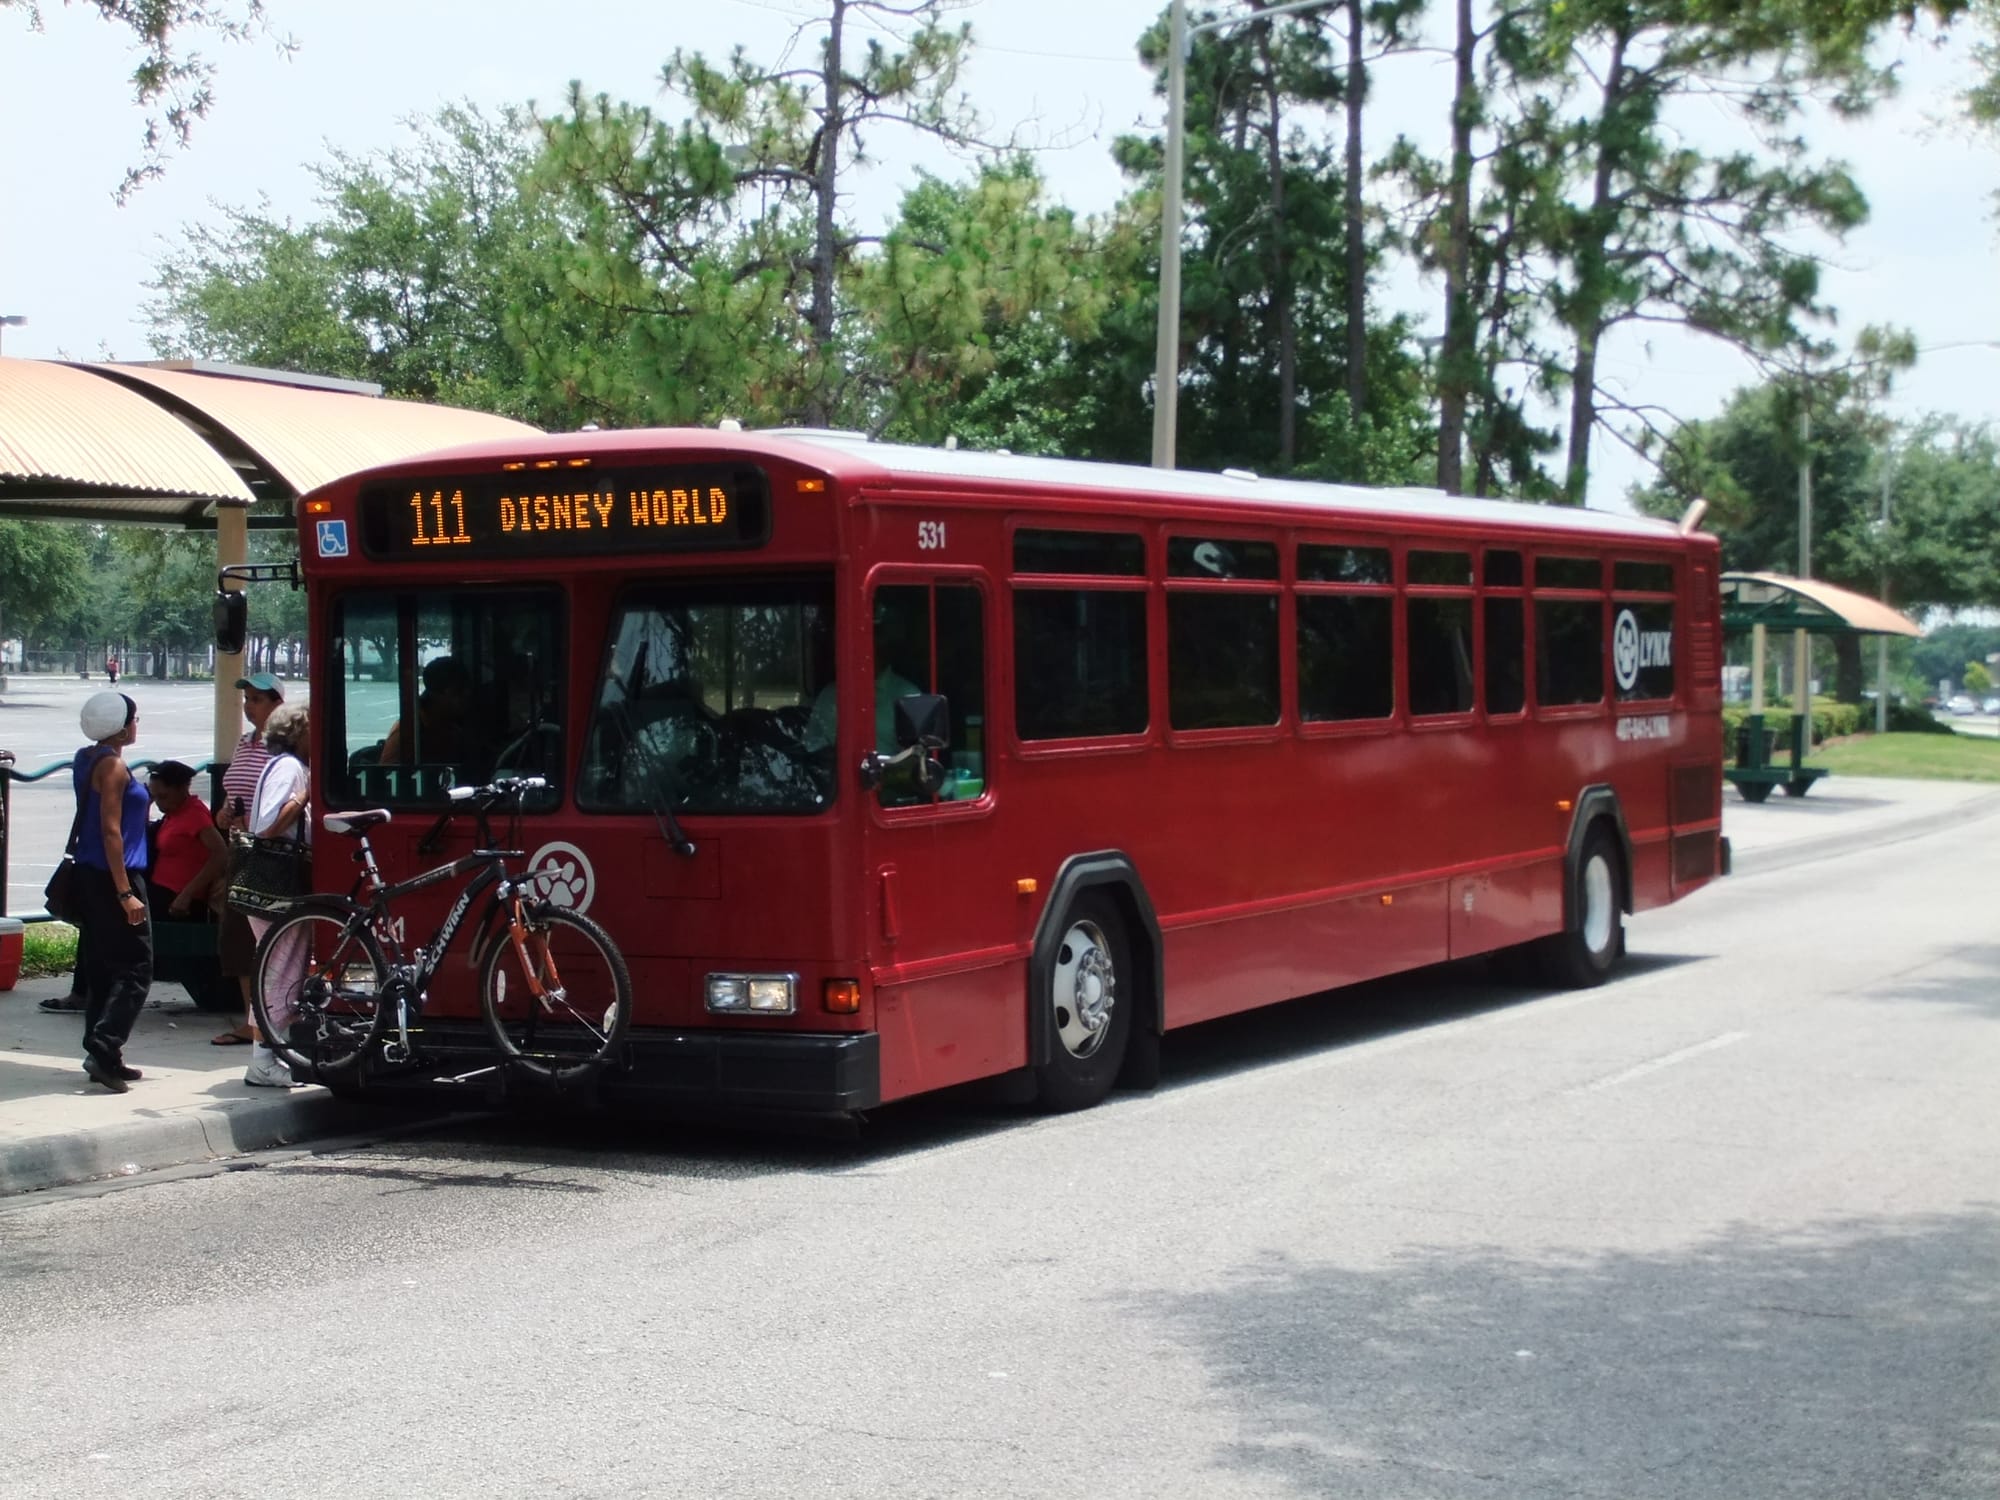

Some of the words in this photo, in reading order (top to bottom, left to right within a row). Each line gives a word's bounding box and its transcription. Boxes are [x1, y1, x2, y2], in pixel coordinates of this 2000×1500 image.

[410, 490, 471, 544] 111
[500, 493, 614, 531] DISNEY
[629, 488, 727, 526] WORLD
[918, 520, 945, 549] 531
[1639, 631, 1672, 667] LYNX
[425, 892, 470, 976] SCHWINN
